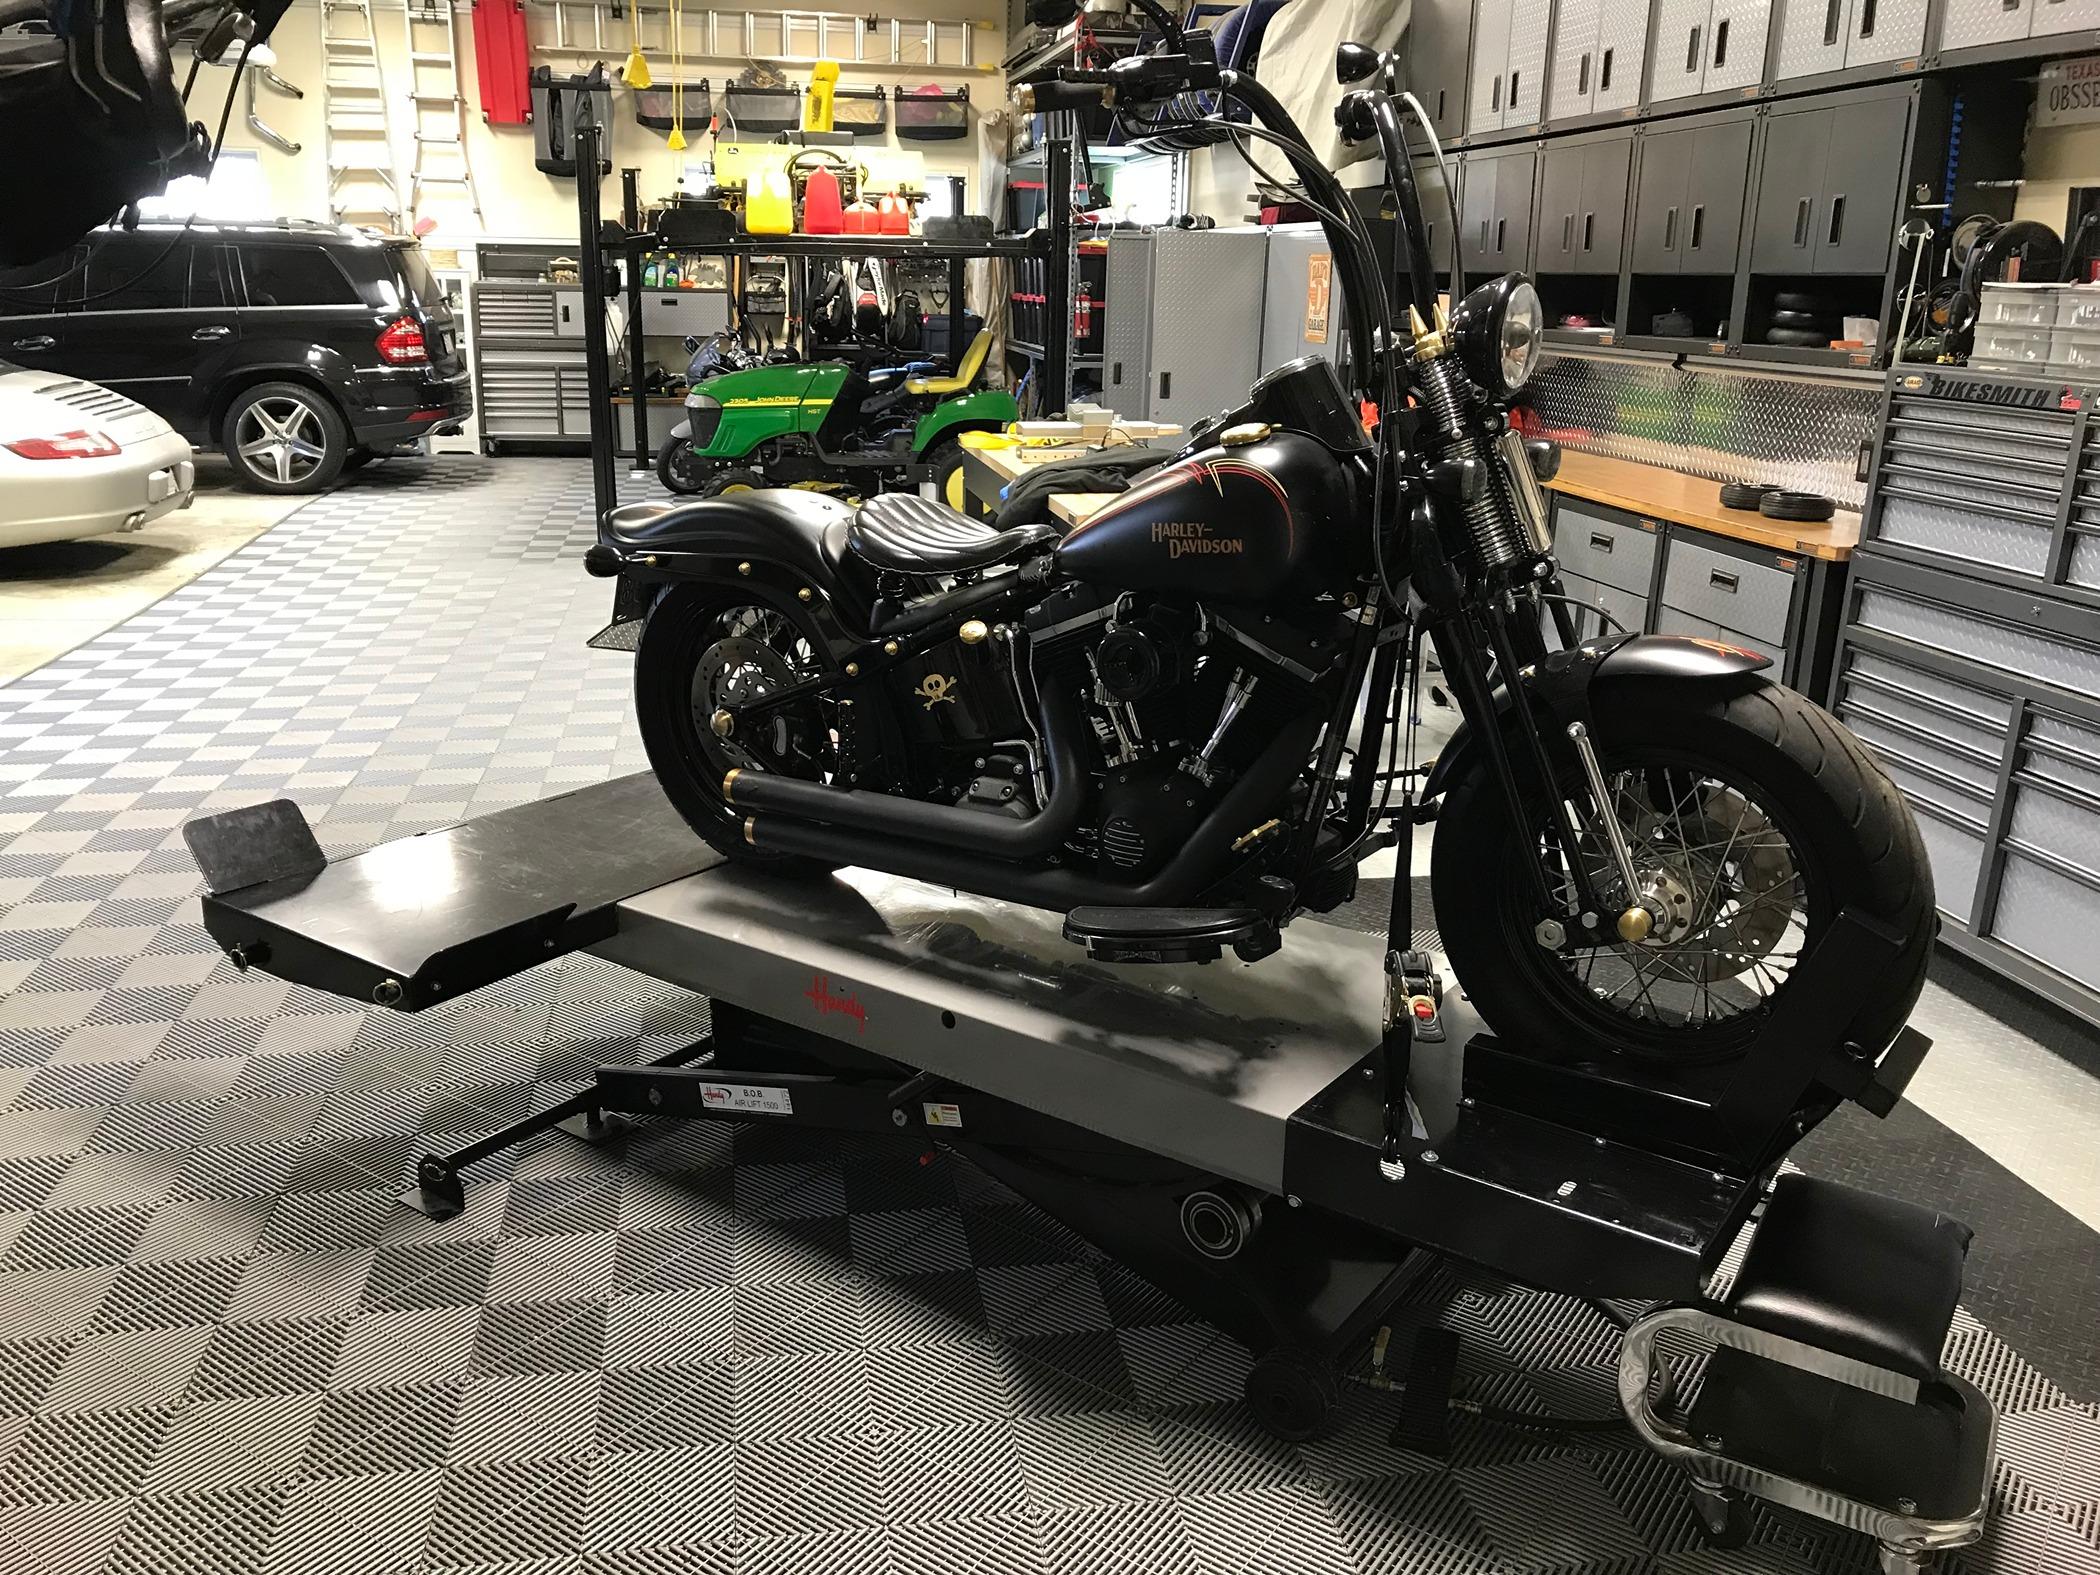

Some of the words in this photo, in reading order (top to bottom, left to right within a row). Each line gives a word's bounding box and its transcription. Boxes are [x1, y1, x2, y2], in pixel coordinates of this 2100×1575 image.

[1930, 378, 2051, 407] BIKESMITH
[1169, 539, 1243, 559] DAVIDSON
[803, 976, 866, 1037] Handy
[734, 1099, 747, 1108] AIR
[763, 1101, 779, 1110] 1500
